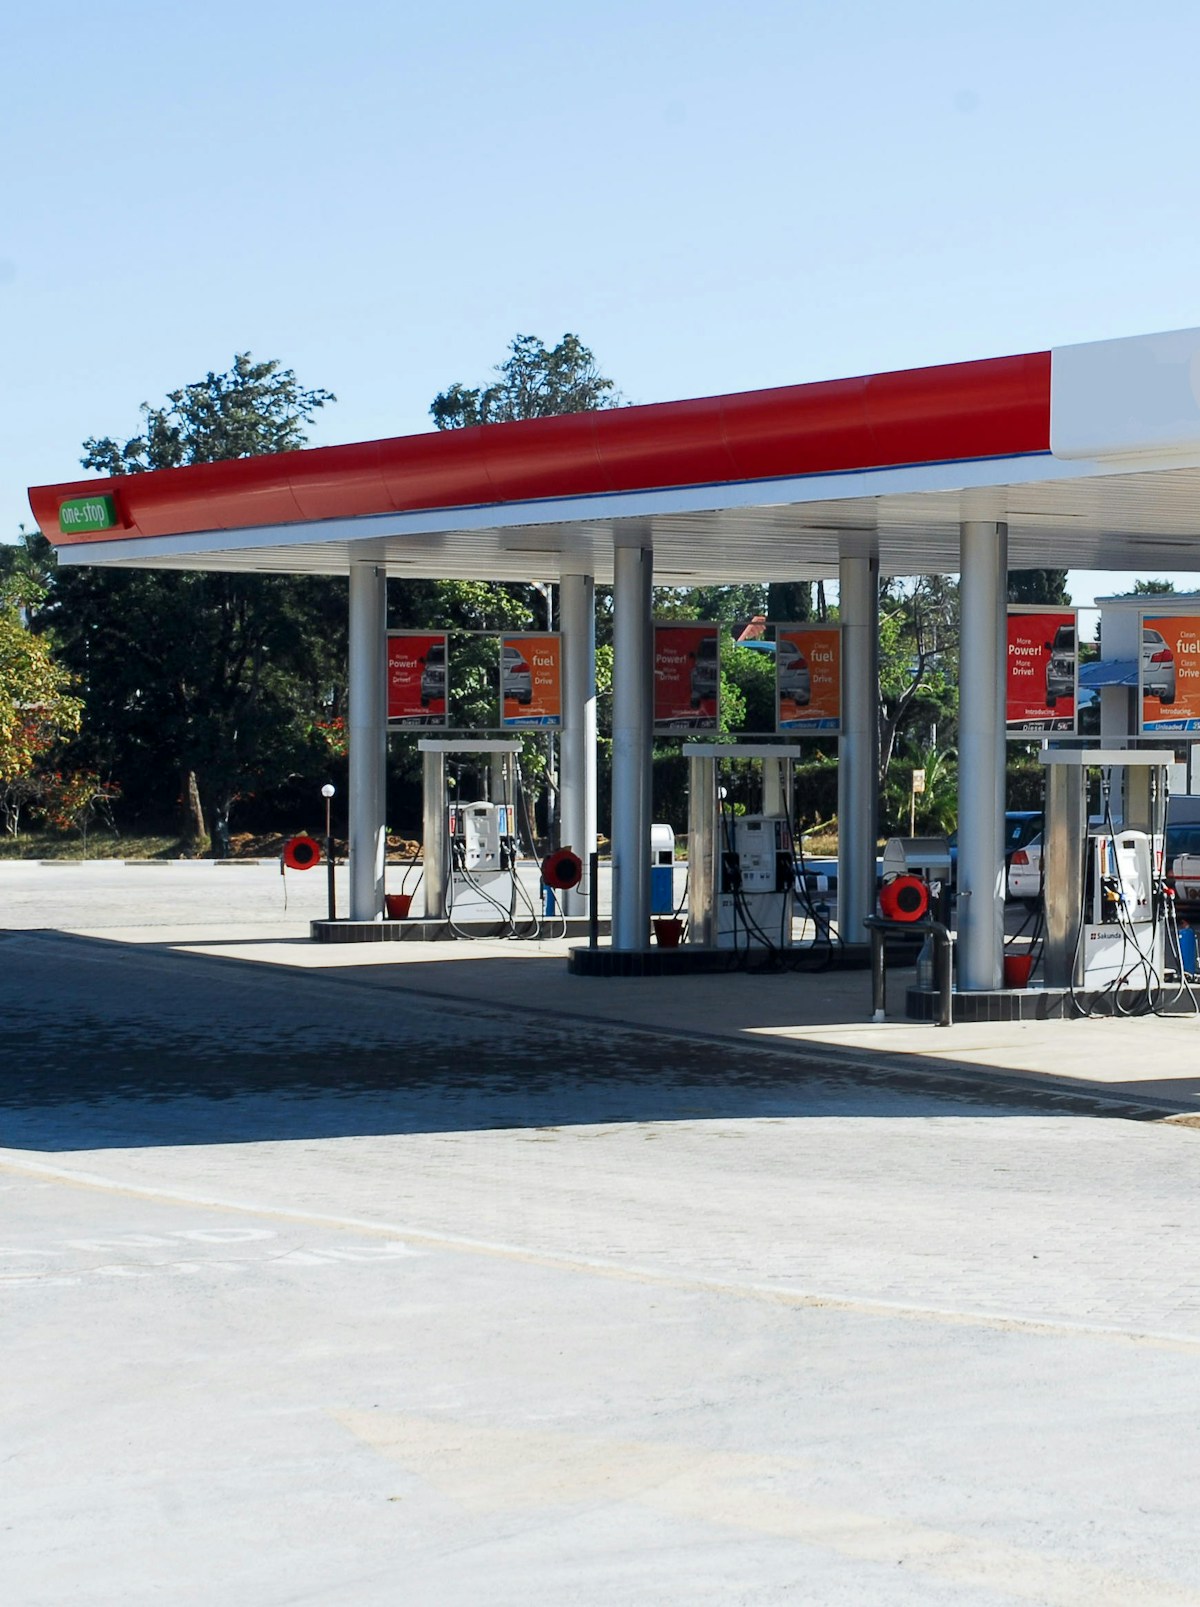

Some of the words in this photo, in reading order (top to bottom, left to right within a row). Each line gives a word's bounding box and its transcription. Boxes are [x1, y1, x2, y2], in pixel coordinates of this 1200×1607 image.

[62, 502, 105, 527] one-stop
[1016, 637, 1032, 645] More
[1008, 644, 1042, 656] Power!
[656, 653, 687, 664] Power!
[810, 649, 834, 662] fuel
[388, 659, 417, 668] Power!
[532, 655, 554, 667] fuel
[1012, 667, 1035, 676] Drive!
[1178, 668, 1200, 678] Drive
[534, 677, 553, 685] Drive
[812, 674, 833, 683] Drive
